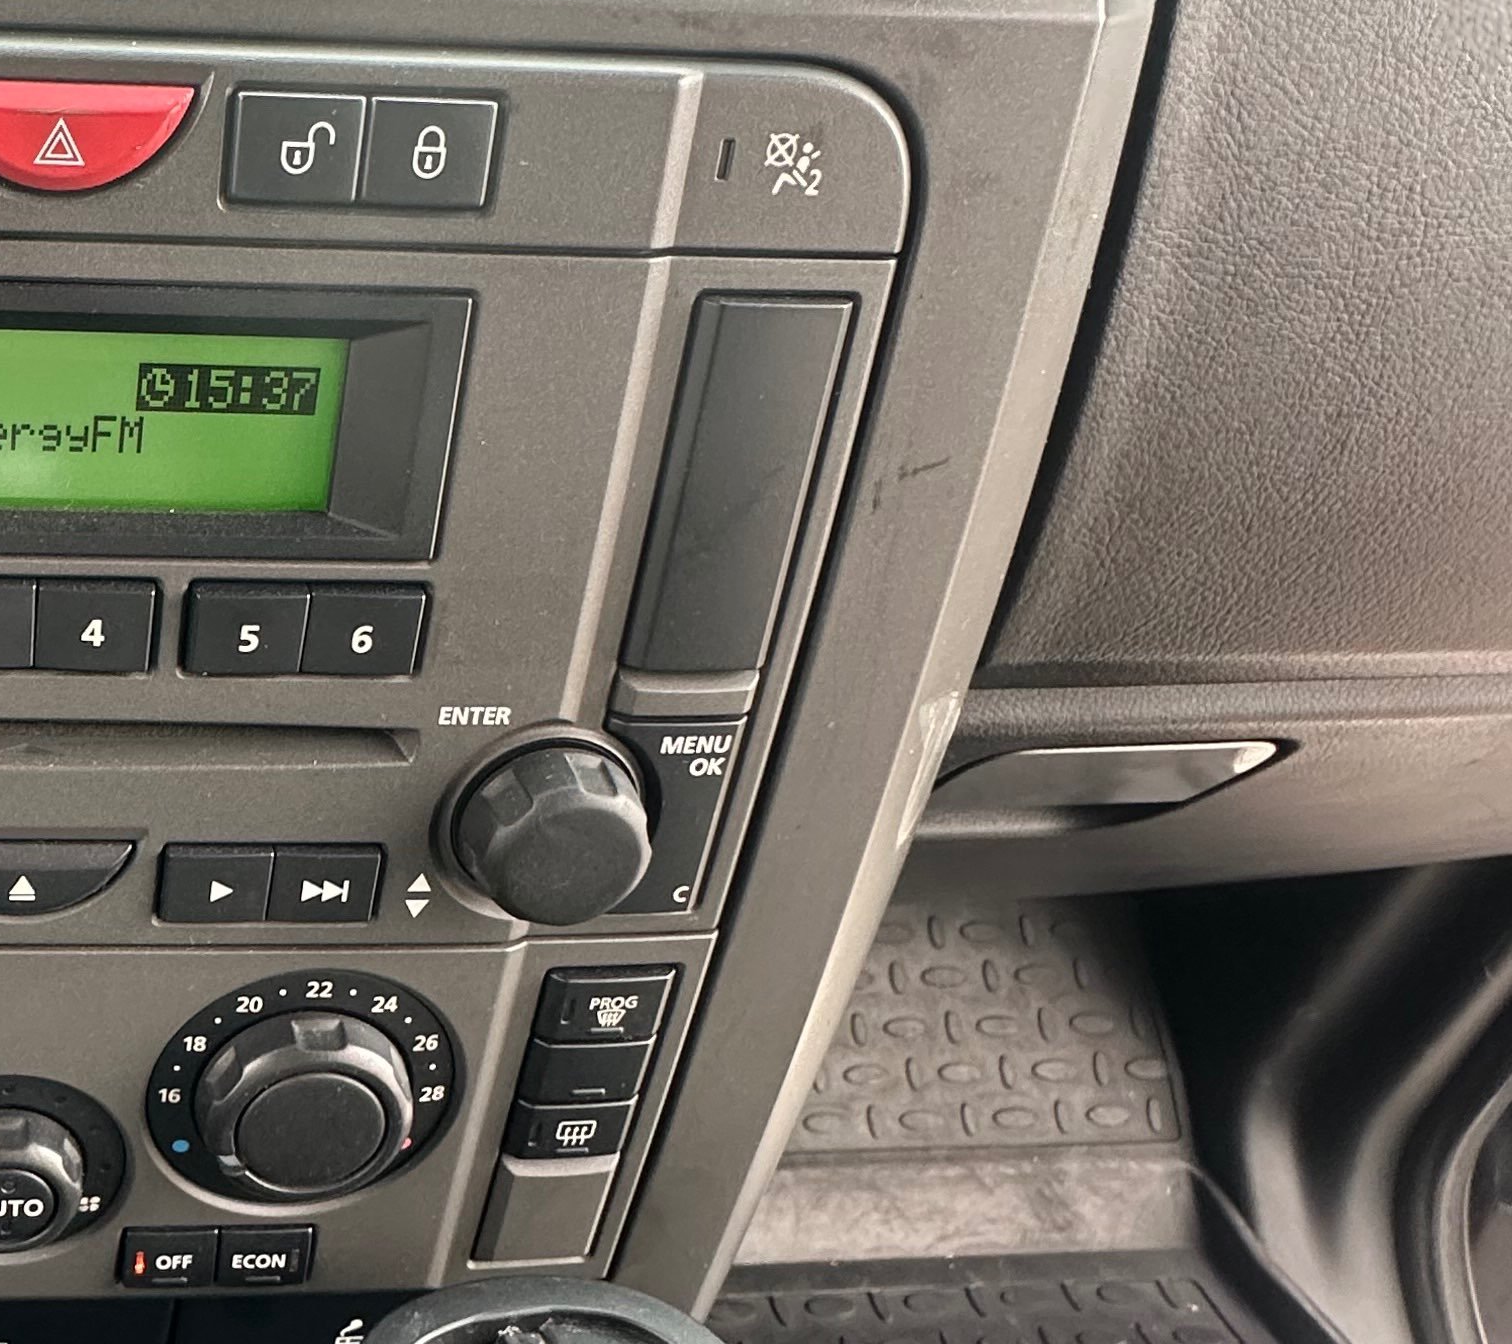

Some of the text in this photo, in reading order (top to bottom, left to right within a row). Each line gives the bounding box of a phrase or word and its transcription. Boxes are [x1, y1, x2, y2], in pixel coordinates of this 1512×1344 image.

[804, 168, 823, 197] 2
[186, 368, 317, 410] 15:37
[80, 619, 105, 647] 4
[238, 624, 260, 653] 5
[351, 625, 374, 654] 6
[438, 706, 512, 726] ENTER
[659, 734, 733, 755] MENU
[688, 756, 727, 777] OK
[672, 885, 690, 903] C
[305, 980, 334, 999] 22
[235, 995, 264, 1013] 20
[370, 995, 398, 1014] 24
[588, 995, 640, 1011] PROG
[183, 1035, 207, 1052] 18
[412, 1033, 439, 1052] 26
[158, 1087, 181, 1104] 16
[418, 1085, 445, 1103] 28
[155, 1254, 193, 1271] OFF
[231, 1253, 287, 1269] ECON
